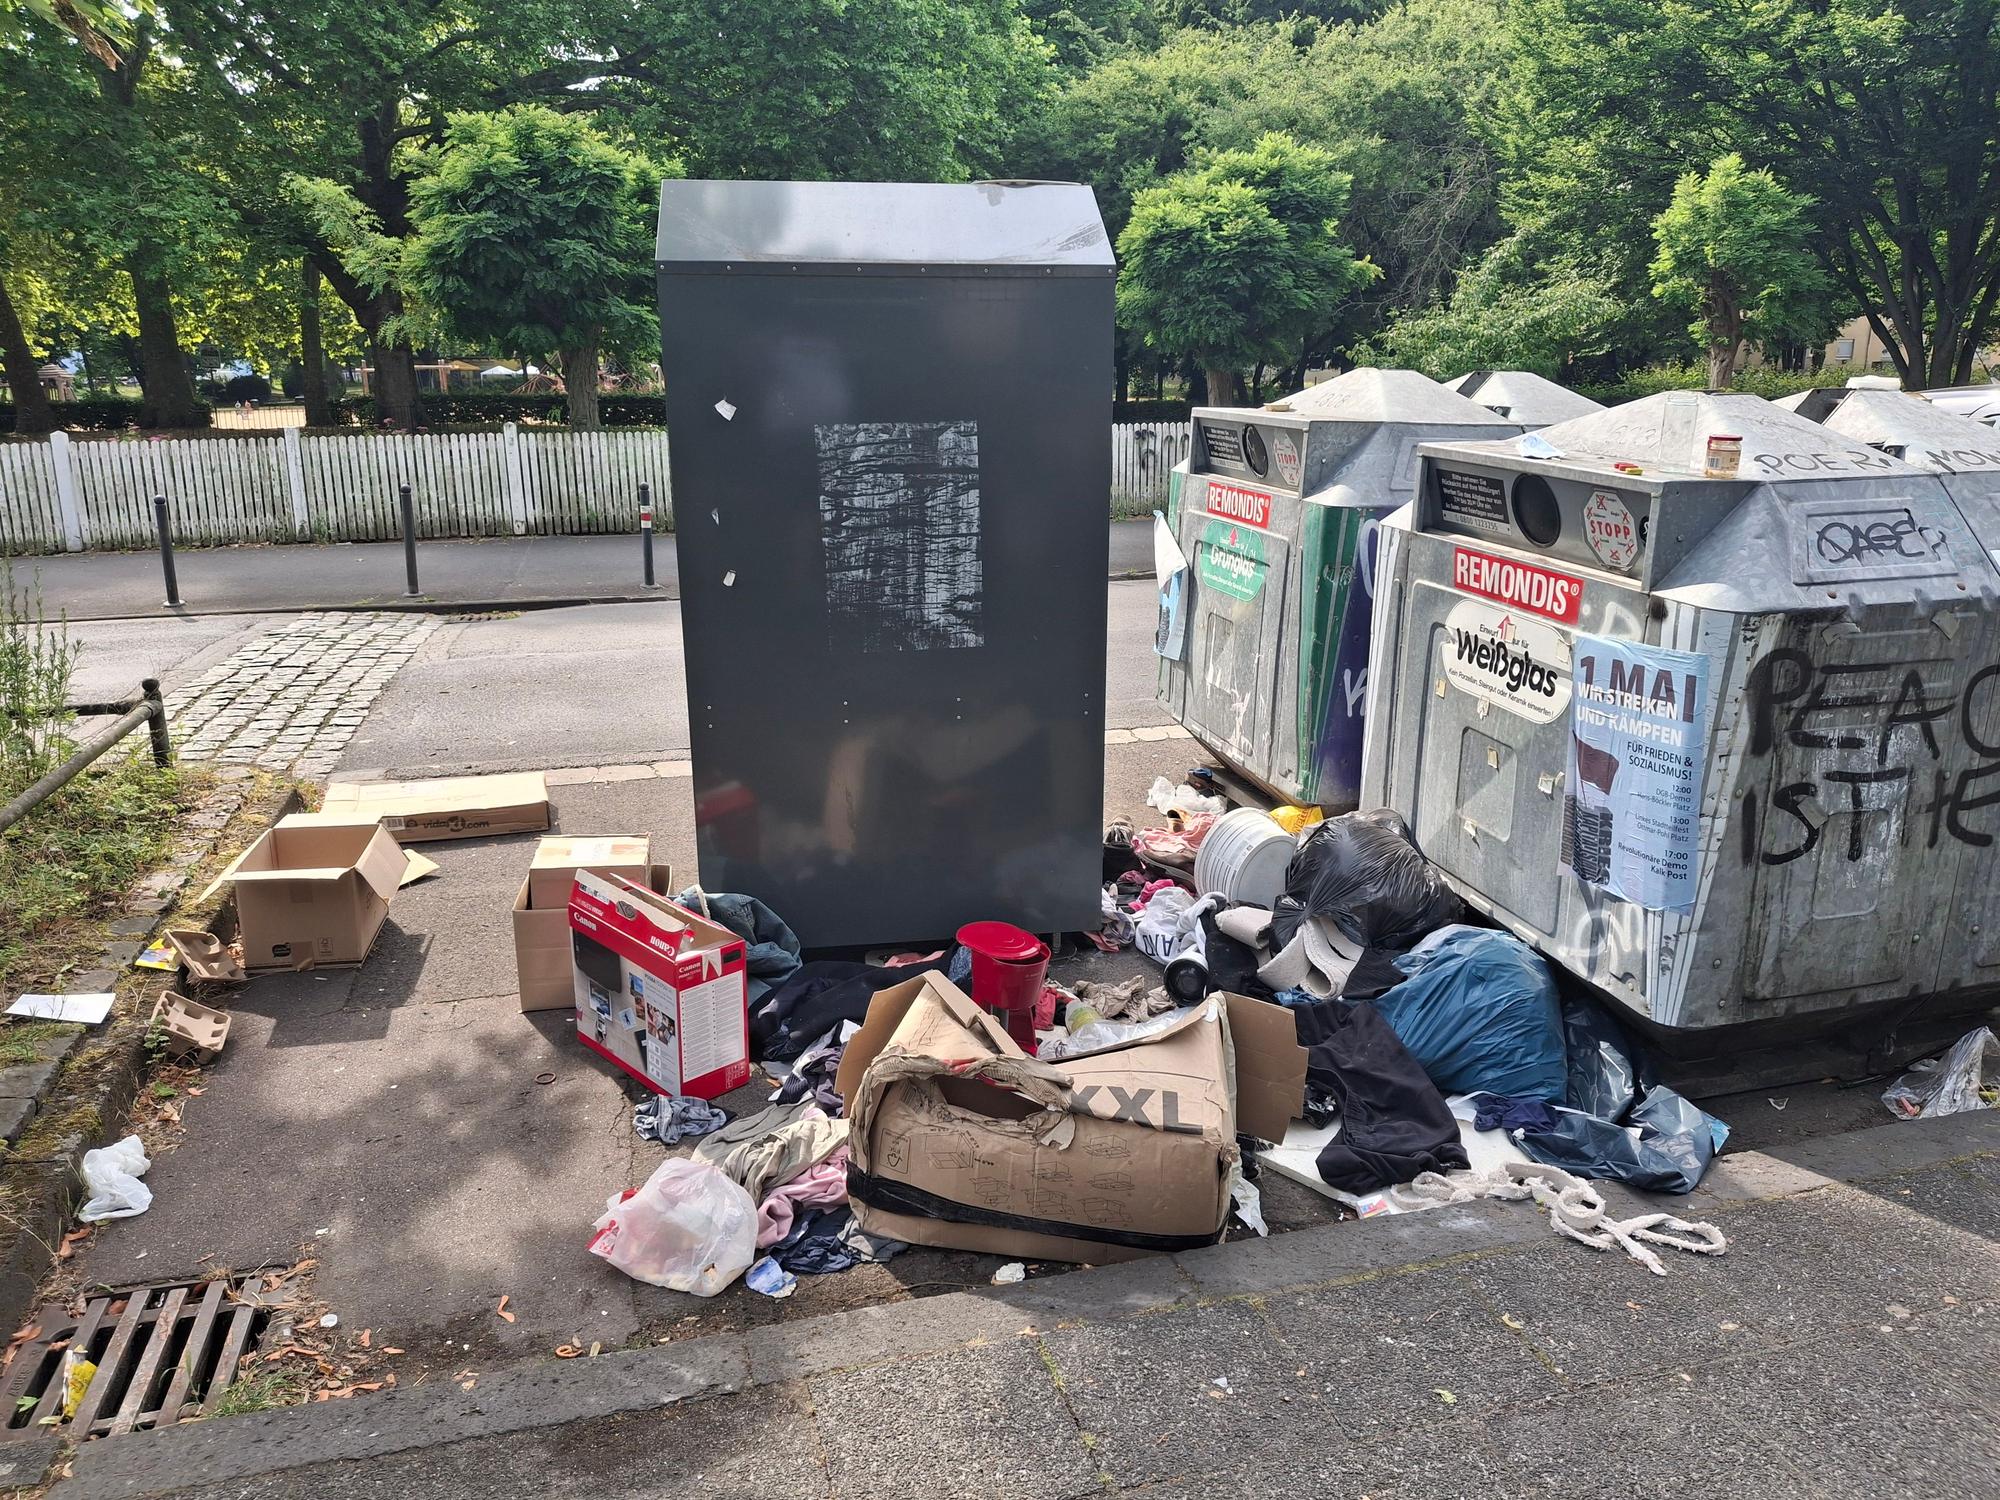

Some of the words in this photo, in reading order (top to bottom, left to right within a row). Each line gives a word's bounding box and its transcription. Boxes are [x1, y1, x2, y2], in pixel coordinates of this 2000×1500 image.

[1590, 520, 1630, 540] STOPP
[1480, 623, 1499, 637] Einwurf
[1457, 627, 1558, 698] Weißglas
[1497, 688, 1508, 698] oder
[1508, 692, 1526, 705] Keramik
[1581, 656, 1595, 687] 1
[1610, 659, 1697, 723] MAI
[1578, 681, 1605, 703] WIR
[1606, 688, 1679, 721] STREIKEN
[1577, 705, 1606, 727] UND
[1609, 711, 1683, 747] KÄMPFEN
[1627, 741, 1643, 754] FÜR
[1645, 746, 1682, 765] FRIEDEN
[1684, 756, 1693, 767] &
[1629, 755, 1692, 780] SOZIALISMUS!
[1656, 788, 1691, 803] DGB-Demo
[1672, 784, 1691, 794] 12:00
[1673, 800, 1690, 811] Platz
[1670, 815, 1690, 825] 13:00
[1670, 832, 1688, 842] Platz
[1618, 842, 1660, 865] Revolutionäre
[1661, 858, 1688, 870] Demo
[1664, 849, 1688, 860] 17:00
[1651, 864, 1666, 876] Kalk
[1667, 867, 1687, 880] Post
[574, 912, 597, 931] Canon
[650, 936, 675, 957] Canon
[679, 962, 701, 973] Canon
